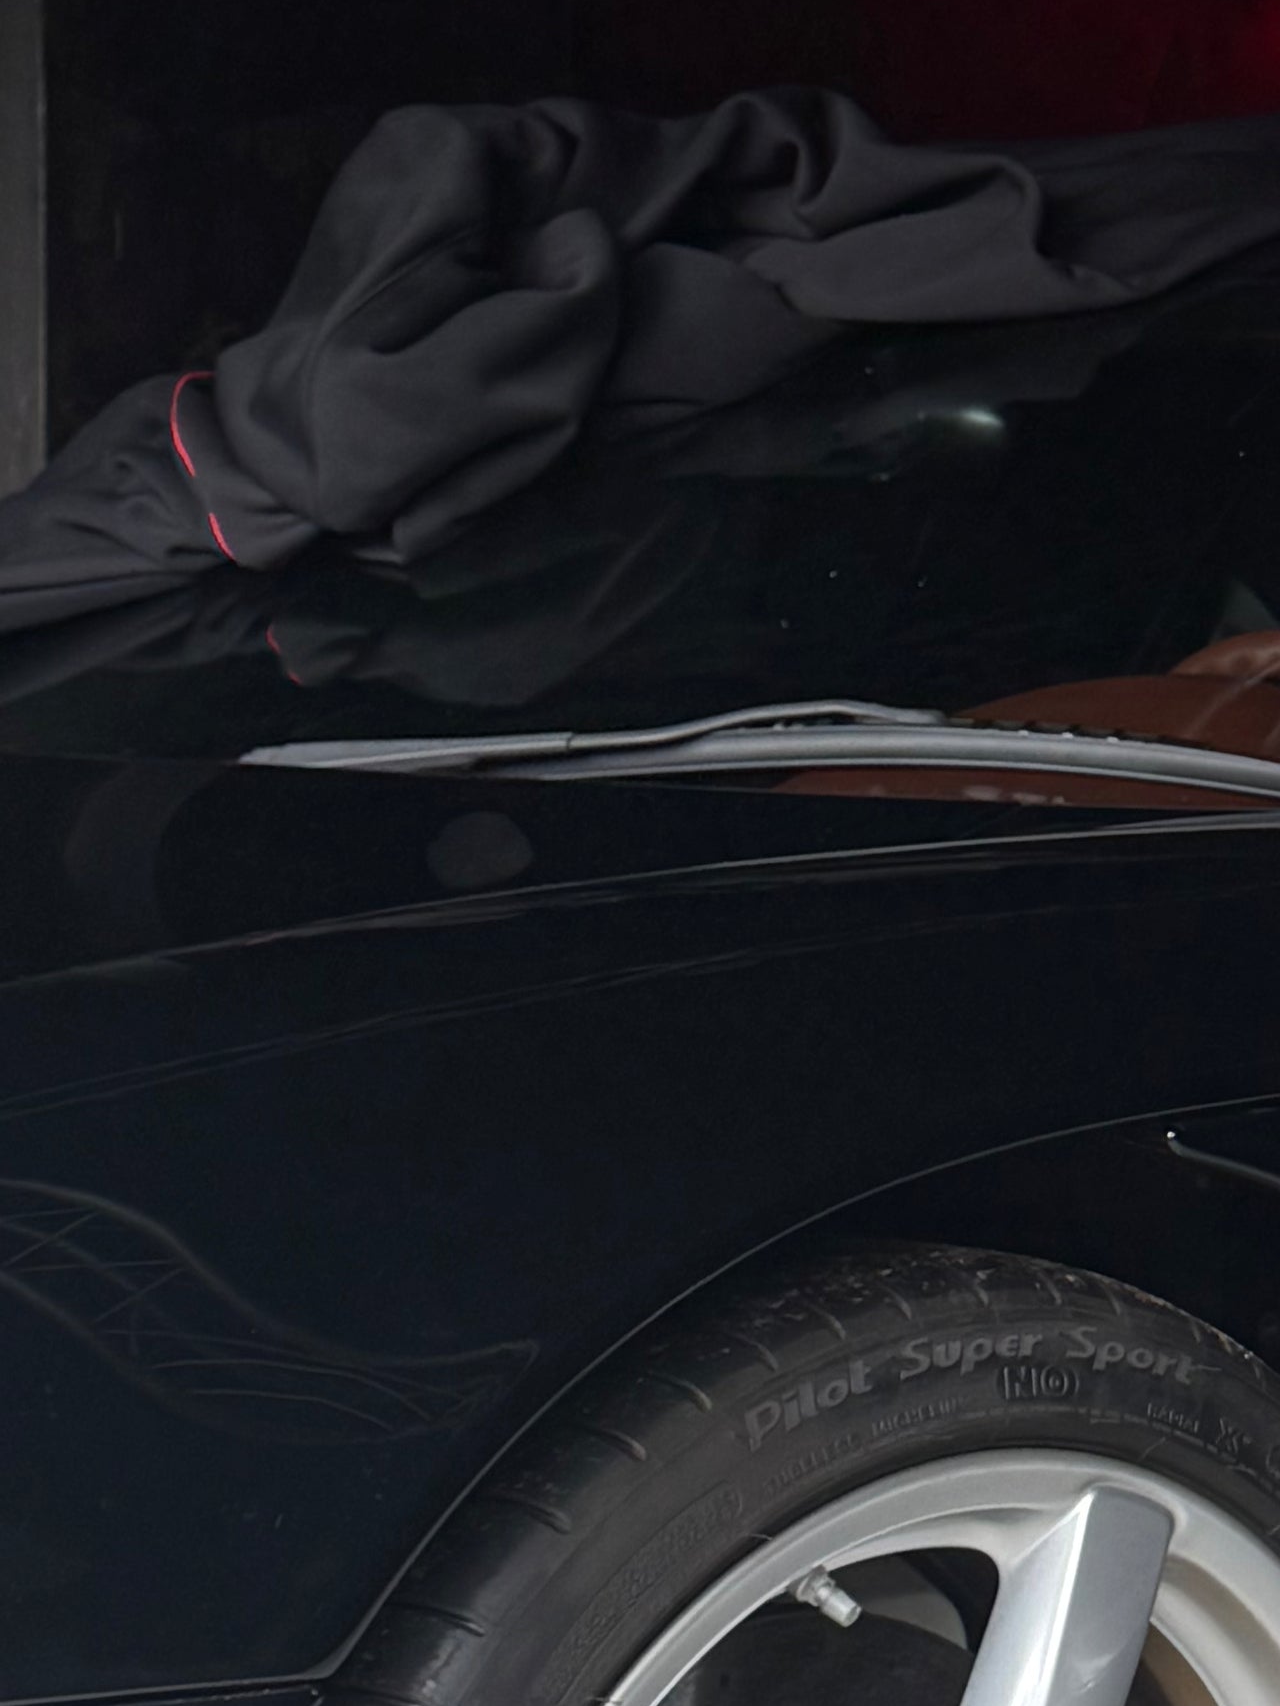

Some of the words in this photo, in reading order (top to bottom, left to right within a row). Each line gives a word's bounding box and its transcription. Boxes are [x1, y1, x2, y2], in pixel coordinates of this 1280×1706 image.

[744, 1359, 871, 1452] Pilot
[900, 1332, 1042, 1380] Super
[1067, 1327, 1220, 1384] Sport
